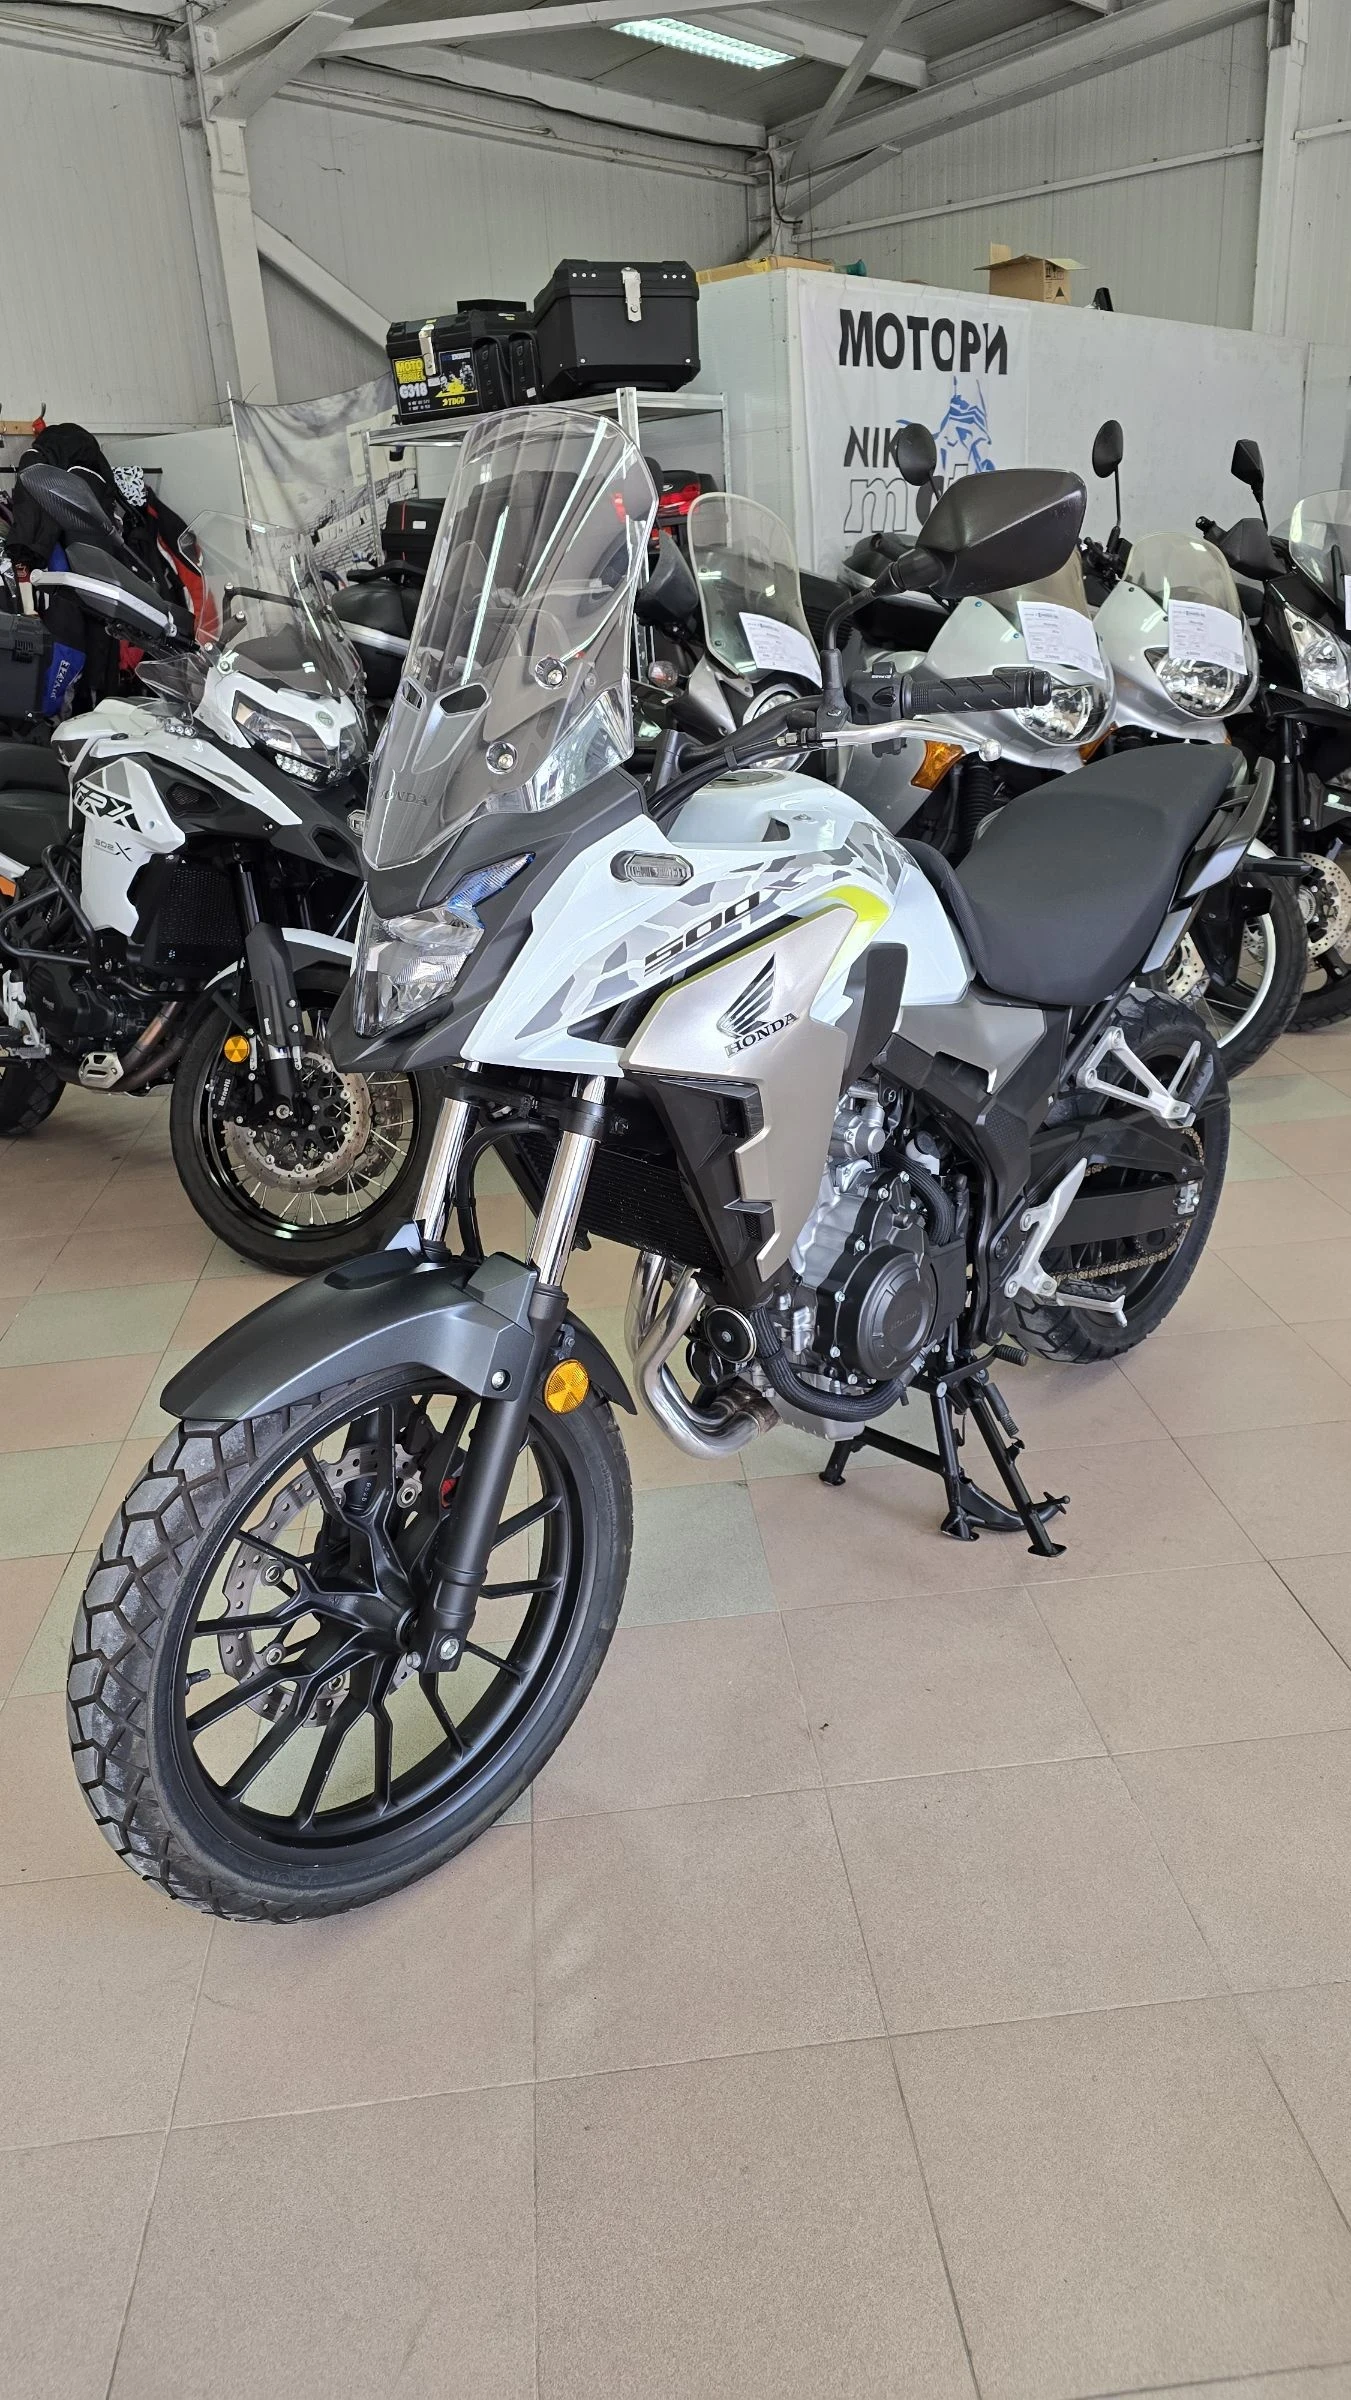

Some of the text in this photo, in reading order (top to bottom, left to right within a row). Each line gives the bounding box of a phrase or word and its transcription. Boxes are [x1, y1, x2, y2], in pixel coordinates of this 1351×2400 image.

[838, 308, 1008, 375] МОТОРИ
[395, 358, 424, 371] MOTO
[400, 382, 428, 399] G318
[843, 425, 904, 468] NIK
[724, 1011, 801, 1059] HONDA
